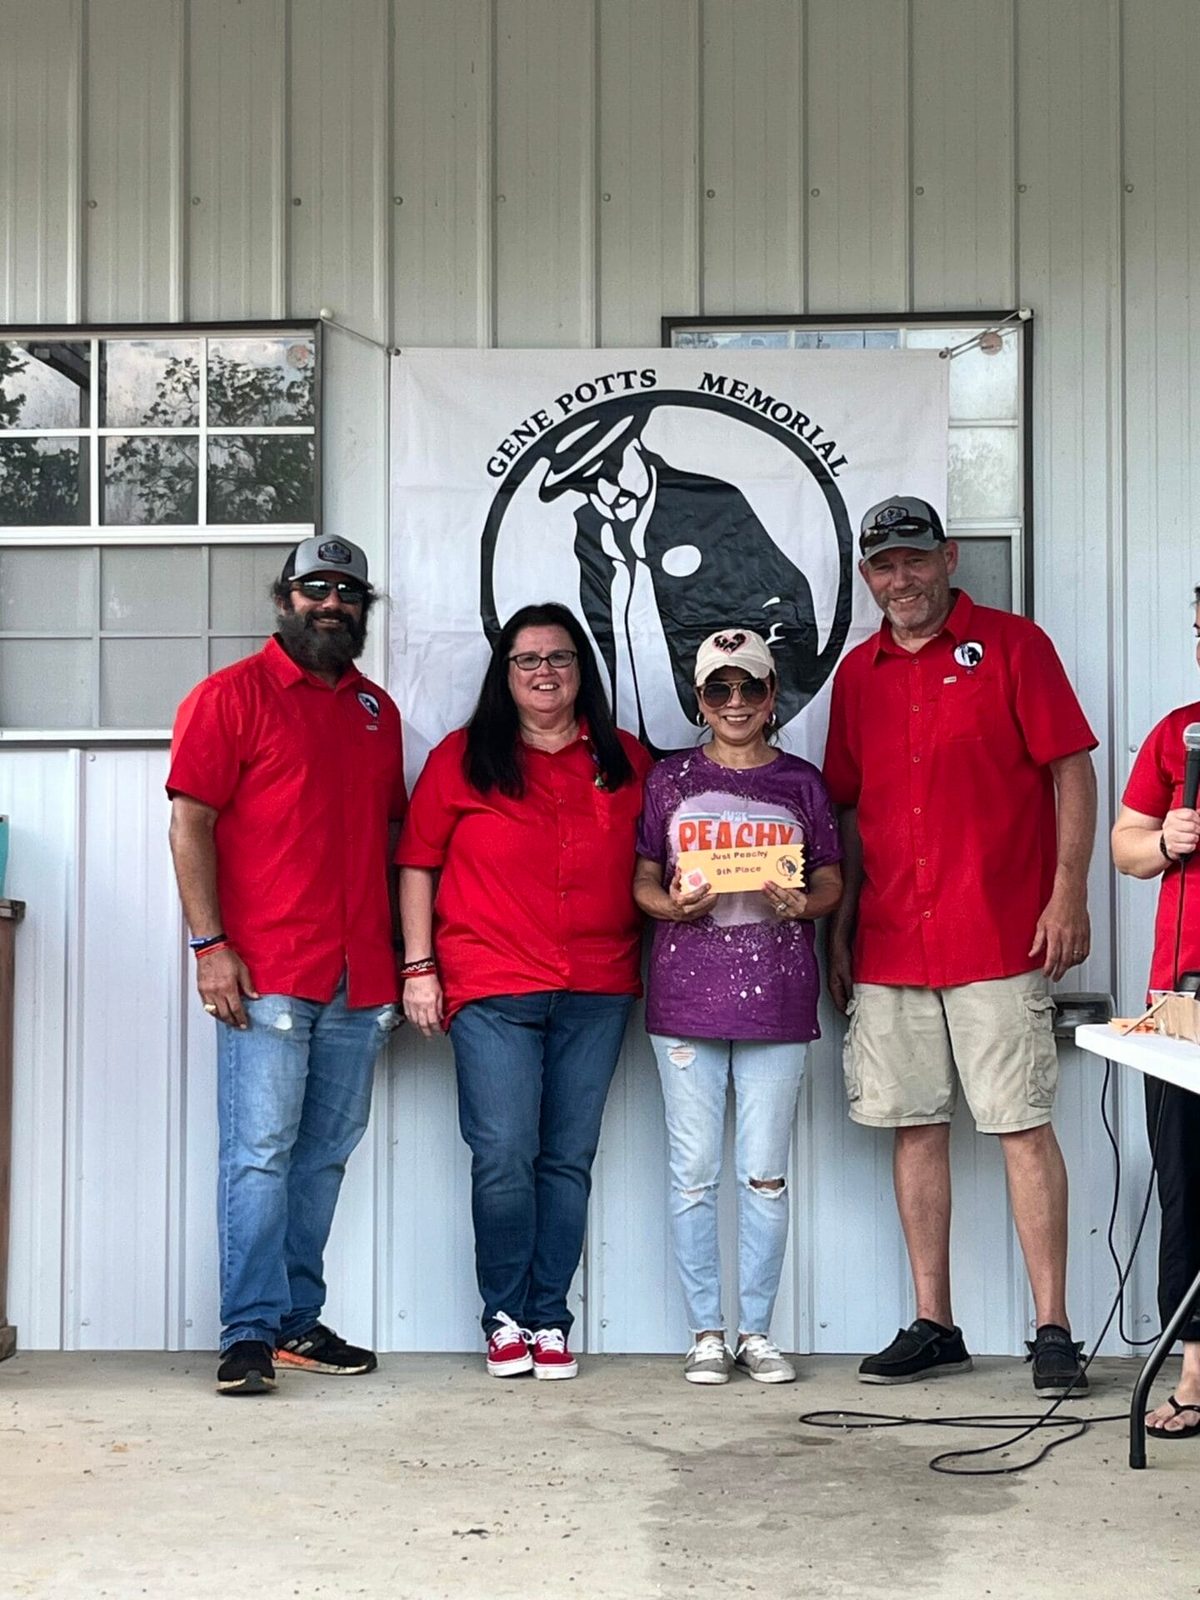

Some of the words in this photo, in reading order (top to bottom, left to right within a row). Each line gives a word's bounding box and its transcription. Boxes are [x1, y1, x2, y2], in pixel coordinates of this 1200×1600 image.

[487, 409, 554, 478] GENE
[554, 369, 657, 415] POTTS
[698, 372, 849, 477] MEMORIAL
[679, 820, 794, 852] PEACHY
[711, 853, 731, 861] Just
[734, 851, 768, 859] Peachy
[735, 866, 762, 874] Place
